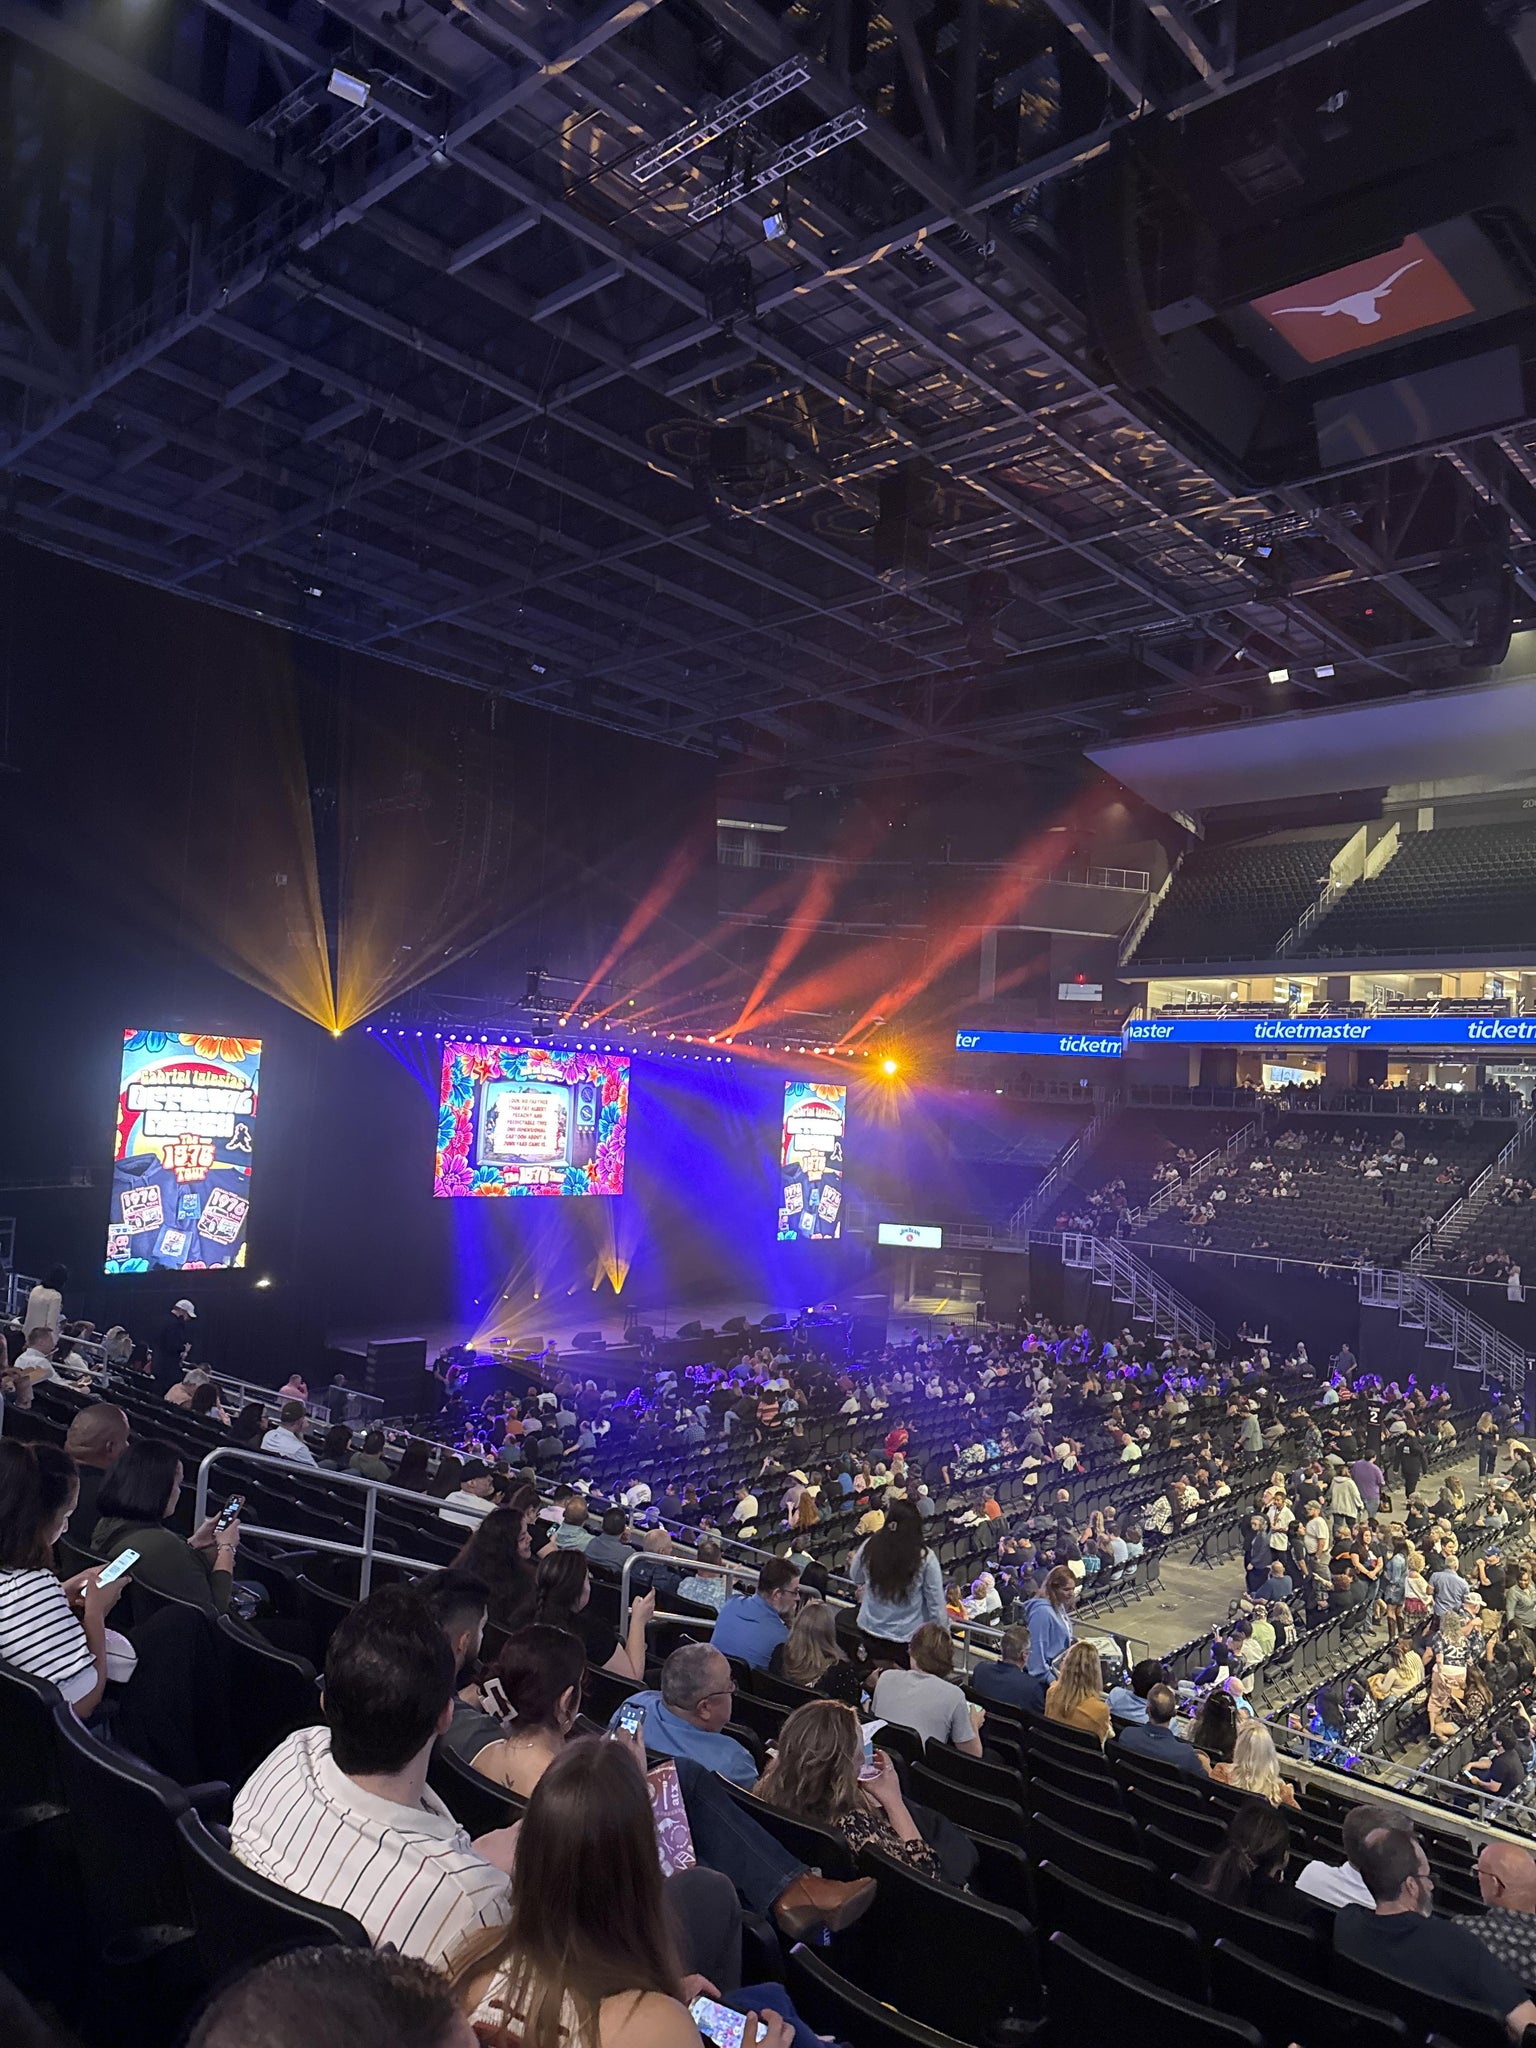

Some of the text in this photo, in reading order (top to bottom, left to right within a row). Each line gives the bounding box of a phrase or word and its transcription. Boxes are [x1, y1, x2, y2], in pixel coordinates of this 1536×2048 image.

[1522, 799, 1536, 809] 20
[1254, 1021, 1371, 1039] ticketmaster
[140, 1069, 246, 1090] Gabriel Iglesias
[162, 1144, 216, 1169] 1976
[123, 1187, 159, 1208] 1976
[211, 1191, 246, 1216] 1976
[1370, 1411, 1378, 1423] 2
[671, 1783, 679, 1806] atx
